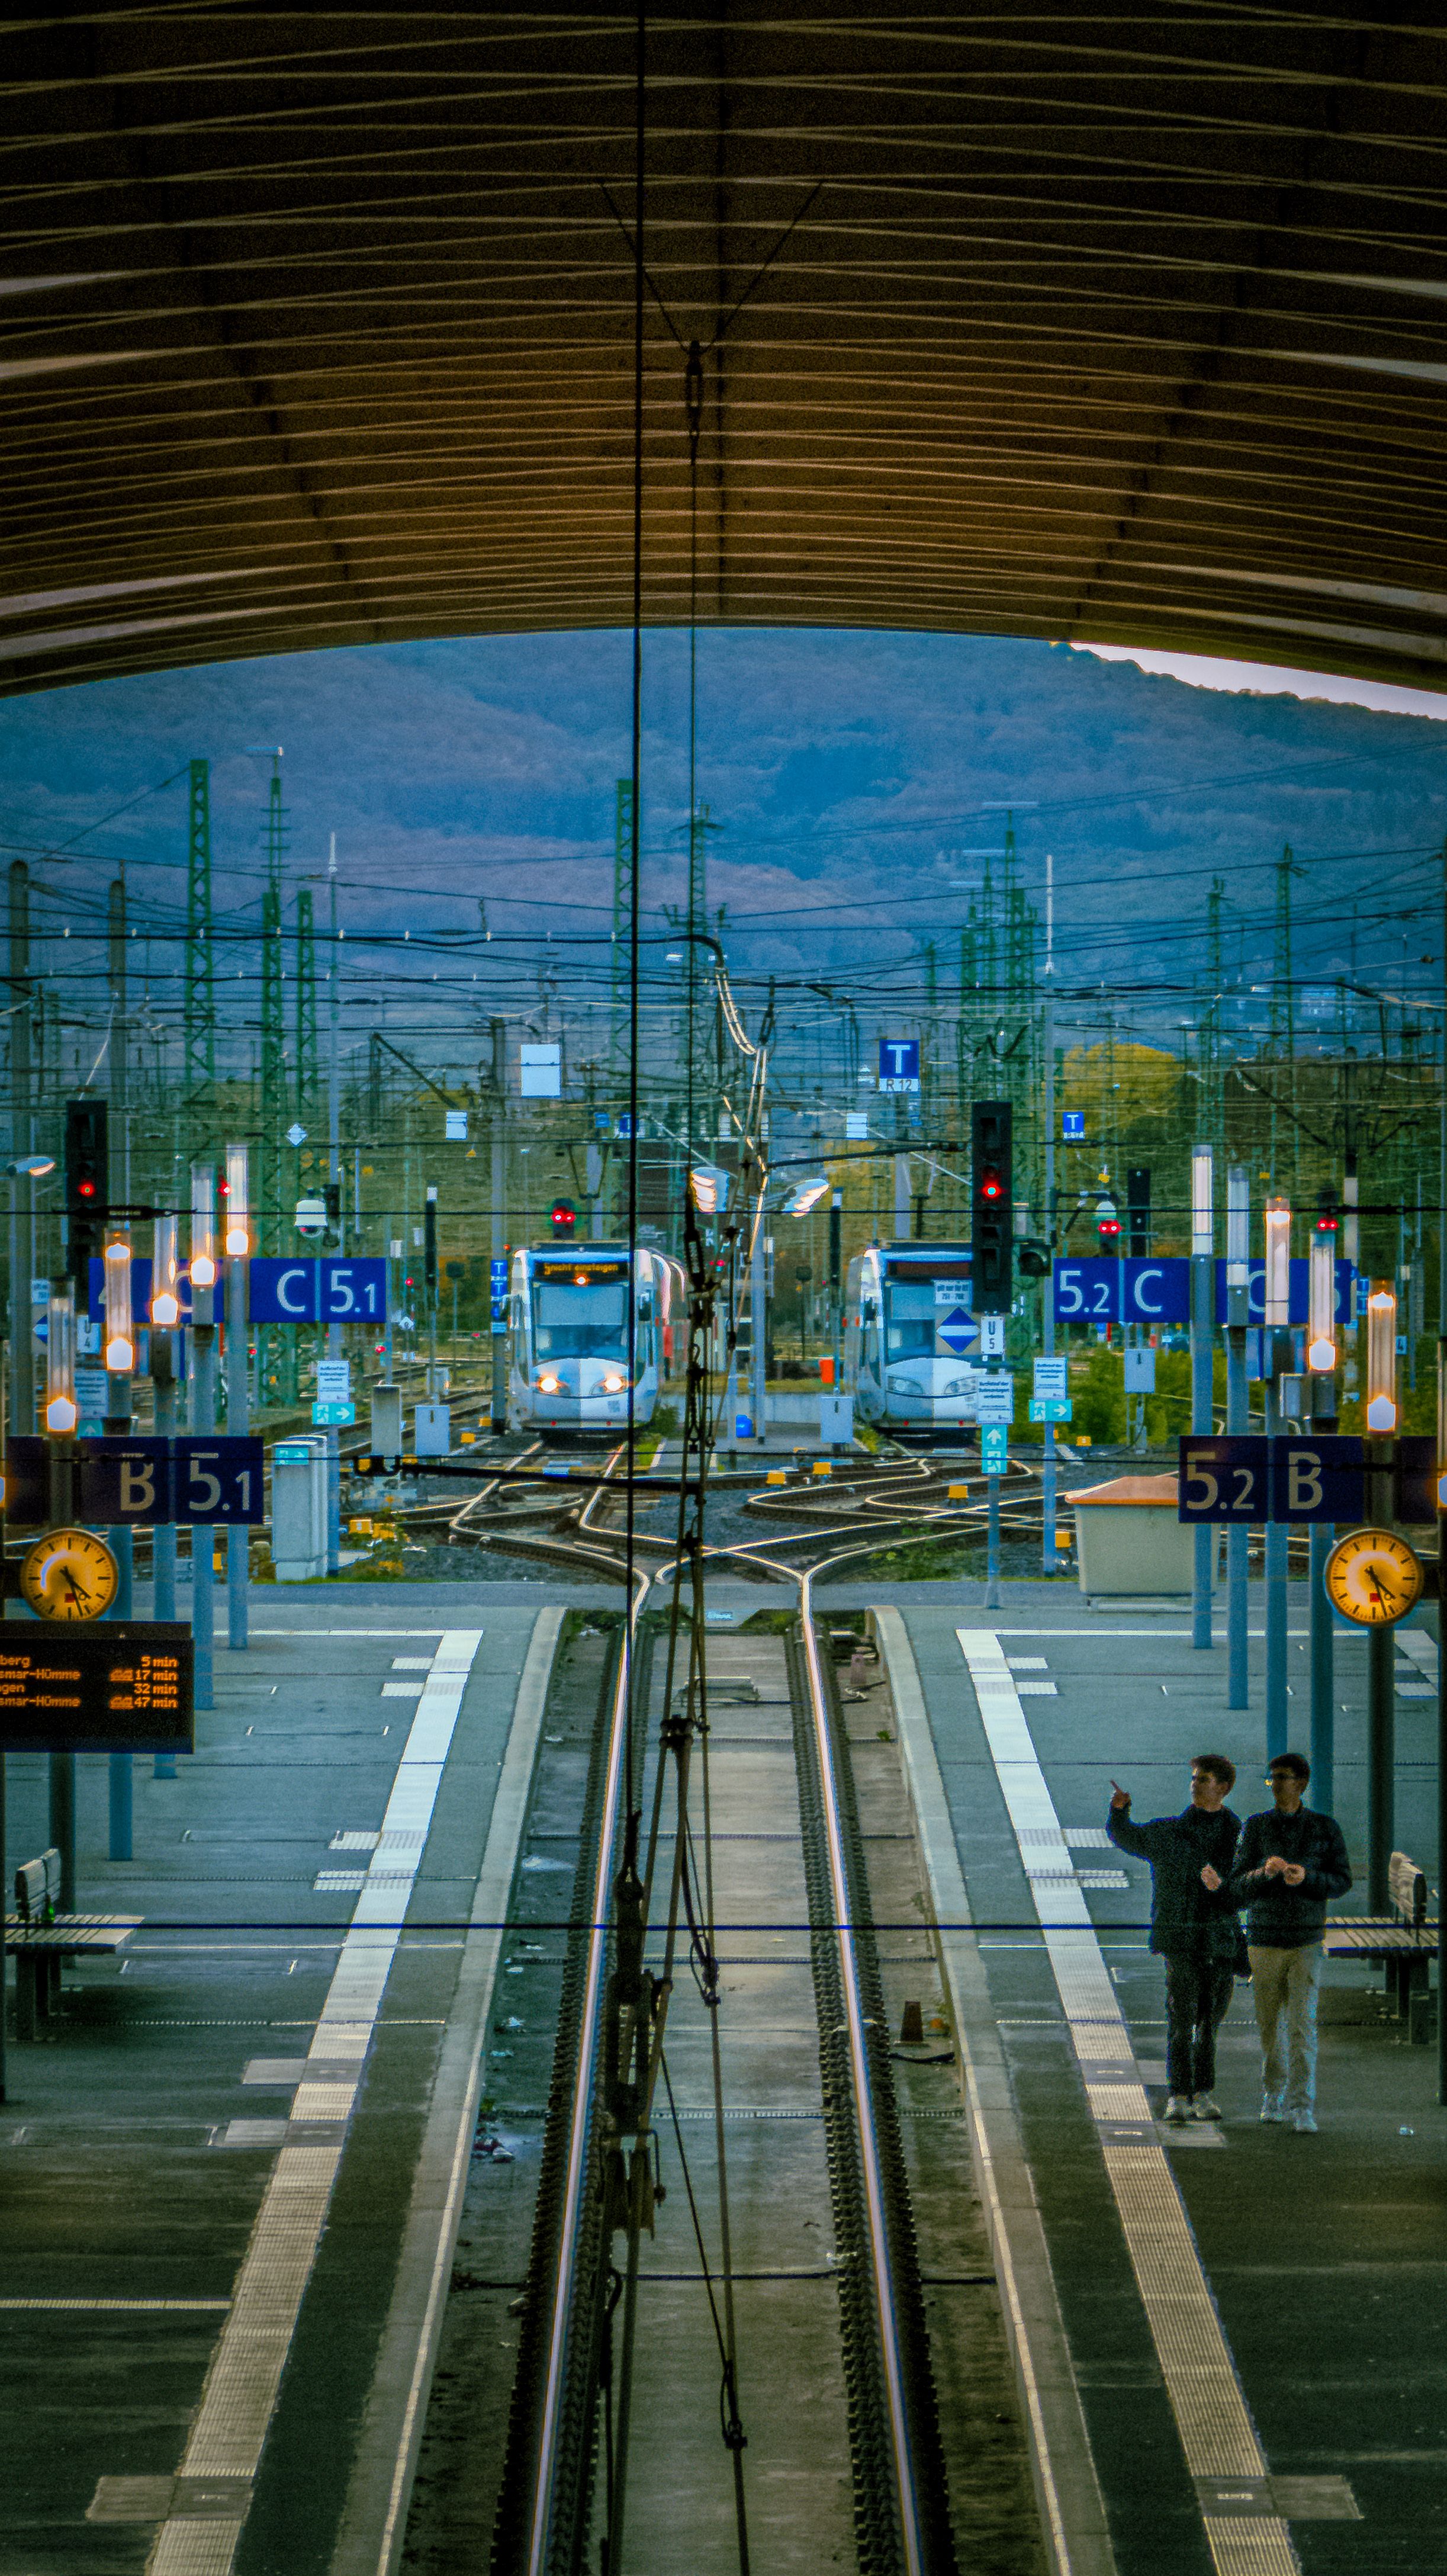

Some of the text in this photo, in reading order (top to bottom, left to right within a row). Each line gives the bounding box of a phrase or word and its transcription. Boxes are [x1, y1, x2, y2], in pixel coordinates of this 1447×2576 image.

[888, 1045, 910, 1073] T
[886, 1079, 912, 1091] R 12
[1066, 1114, 1079, 1129] T
[494, 1262, 503, 1274] T
[276, 1269, 306, 1313] C
[330, 1270, 375, 1313] 5.1
[1060, 1270, 1110, 1313] 5.2
[1134, 1270, 1162, 1312] C
[988, 1321, 995, 1335] U
[120, 1453, 155, 1510] B
[189, 1453, 250, 1510] 5.1
[1186, 1452, 1254, 1509] 5.2
[1289, 1452, 1323, 1509] B
[0, 1655, 178, 1668] berg 5 min
[136, 1670, 150, 1680] 17
[153, 1671, 178, 1681] min
[0, 1684, 178, 1694] gen 32 min
[134, 1697, 150, 1707] 47
[153, 1698, 178, 1708] min
